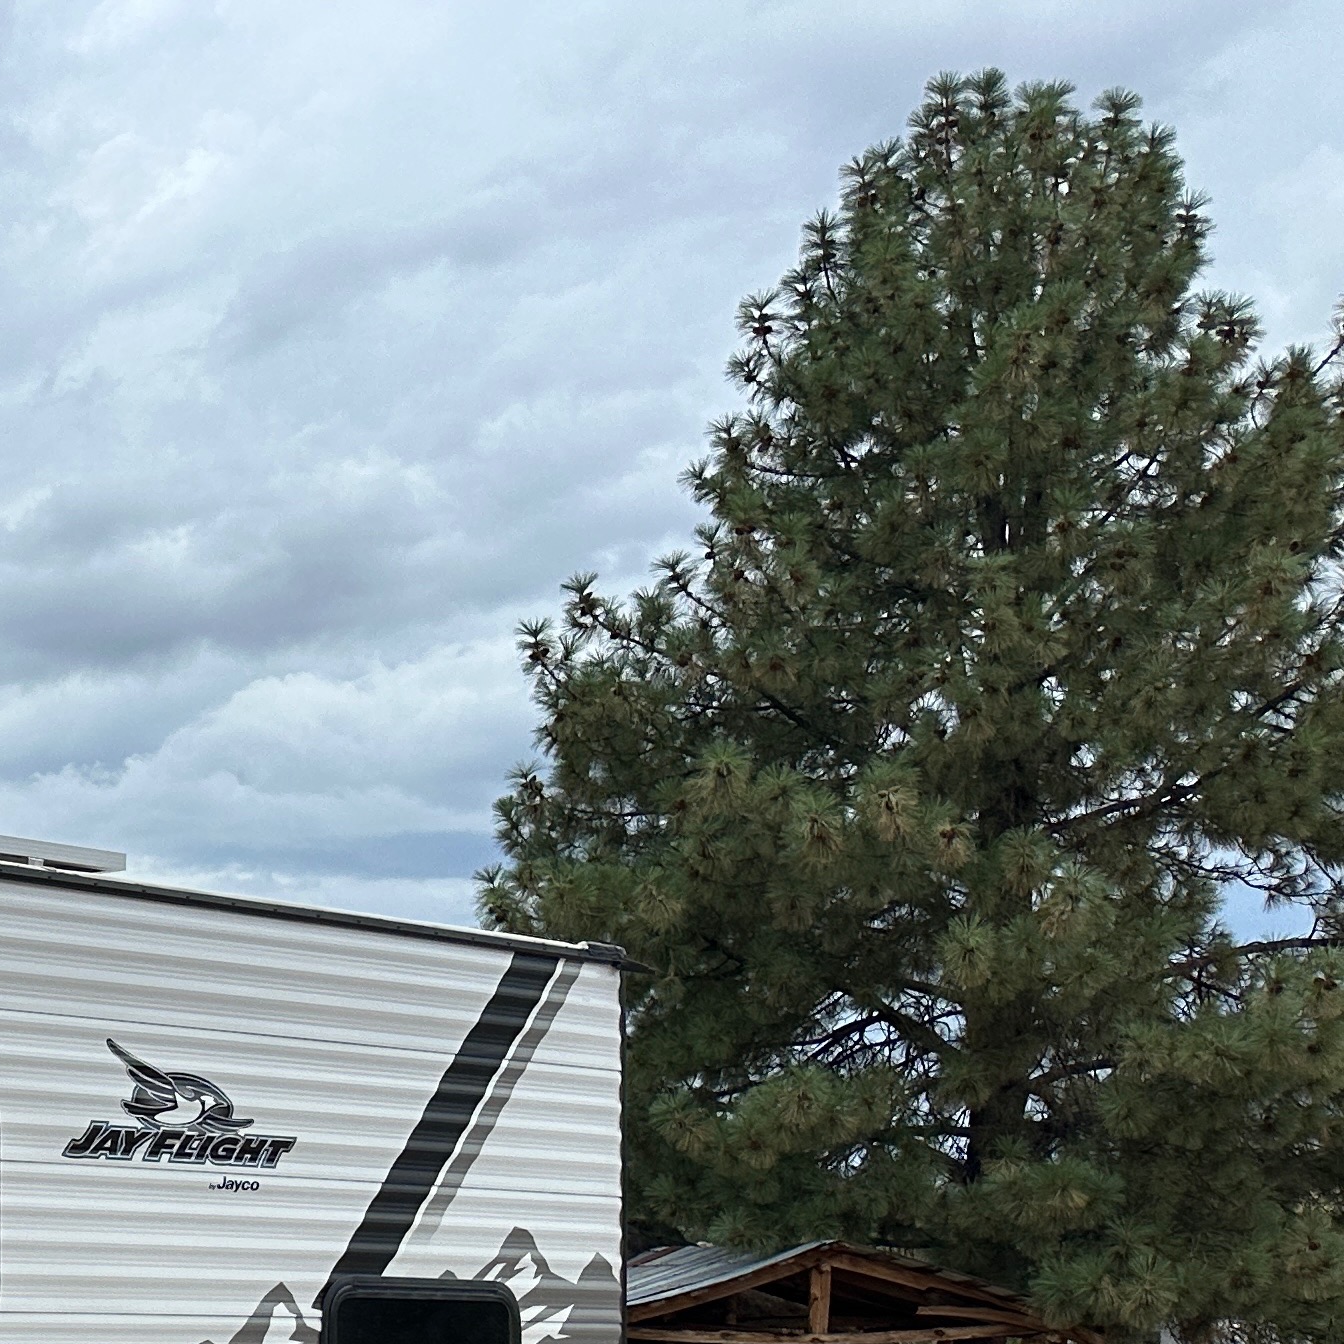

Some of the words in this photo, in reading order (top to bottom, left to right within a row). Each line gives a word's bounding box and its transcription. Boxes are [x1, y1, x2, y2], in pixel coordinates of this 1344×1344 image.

[62, 1120, 153, 1161] JAY
[142, 1127, 298, 1169] FLIGHT
[216, 1176, 260, 1193] Jayco
